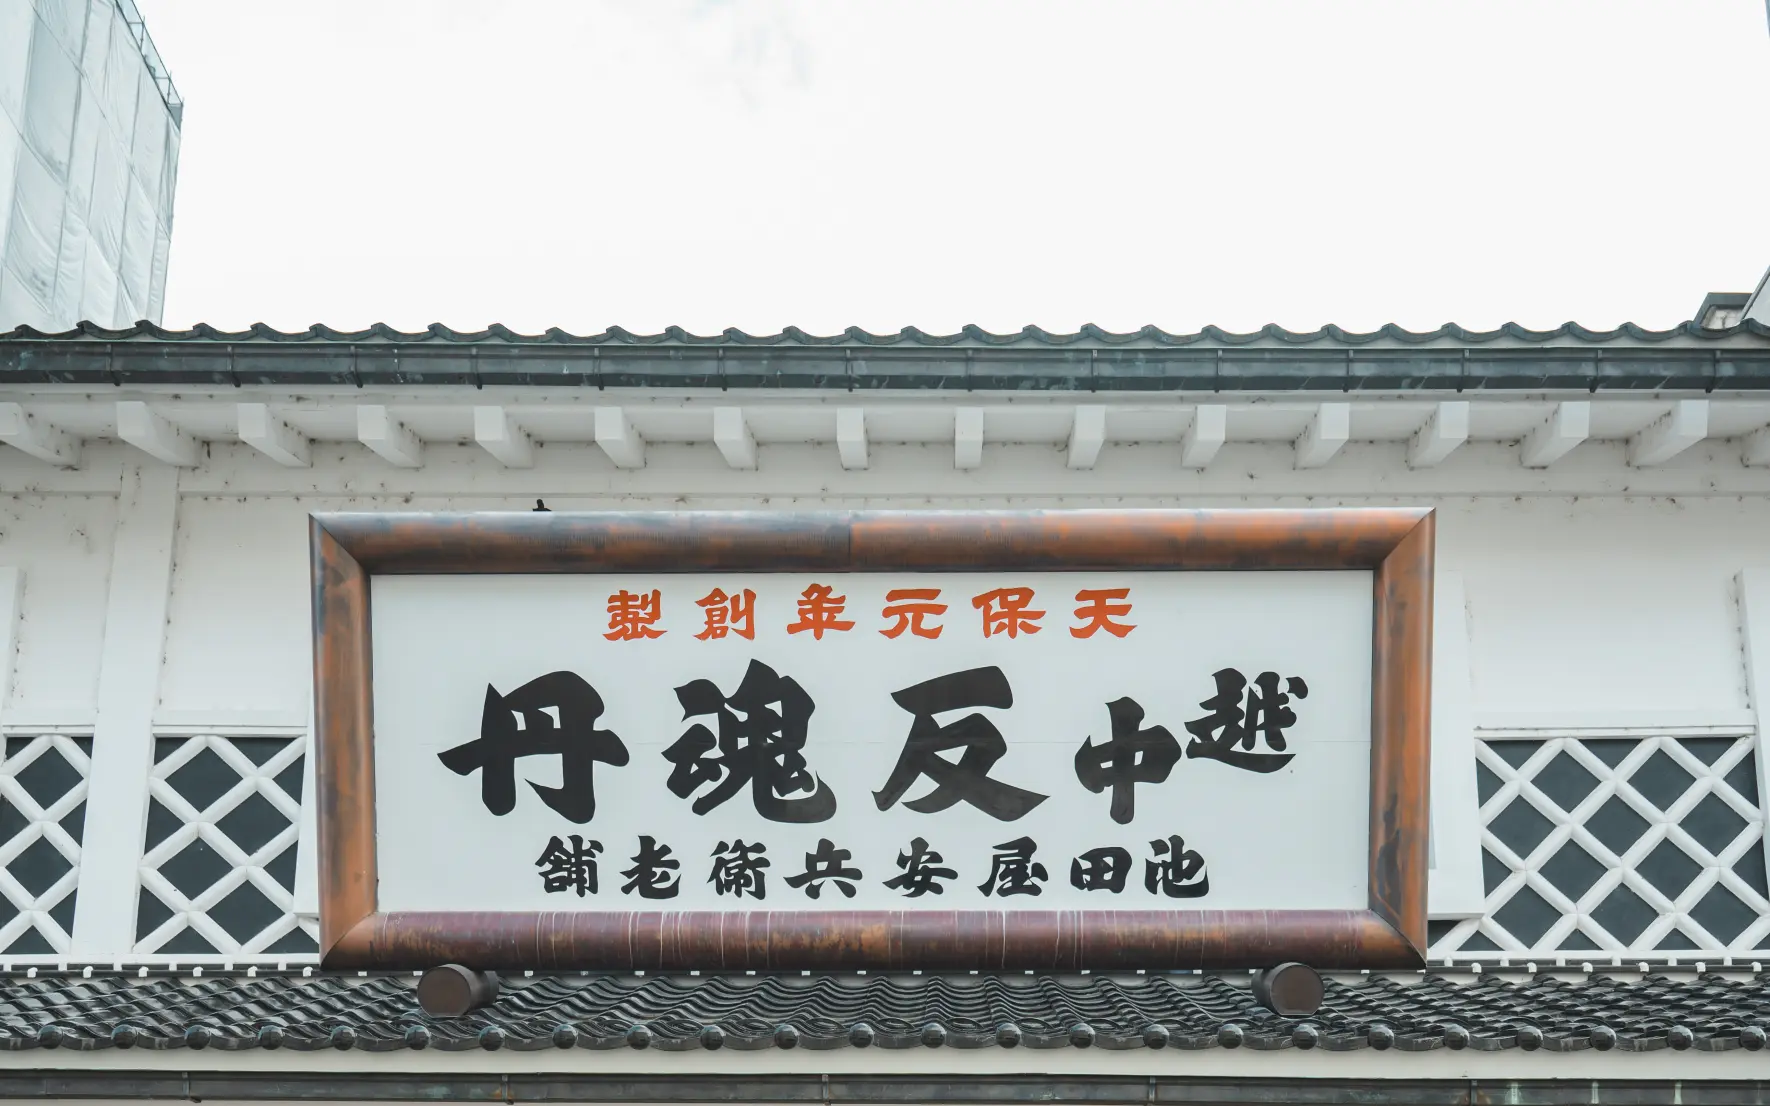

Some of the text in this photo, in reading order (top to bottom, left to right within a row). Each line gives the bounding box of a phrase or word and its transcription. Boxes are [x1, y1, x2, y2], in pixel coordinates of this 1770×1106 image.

[437, 659, 1309, 825] 越中反魂丹
